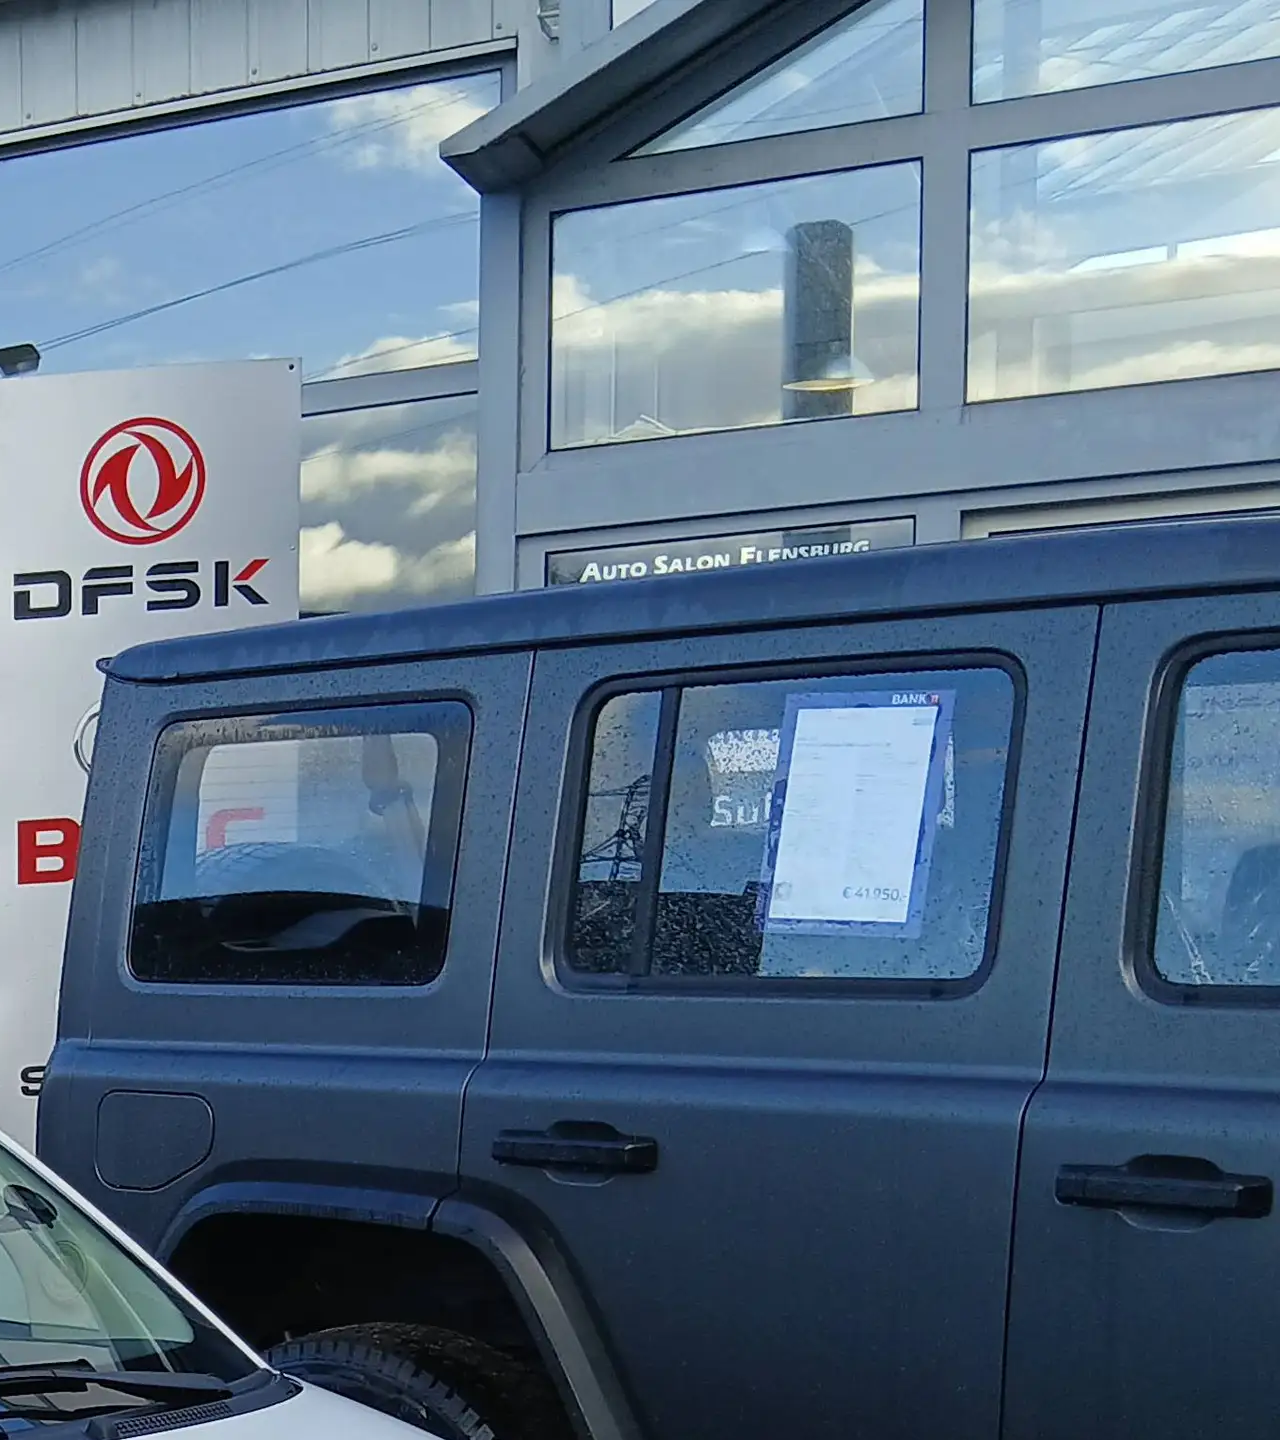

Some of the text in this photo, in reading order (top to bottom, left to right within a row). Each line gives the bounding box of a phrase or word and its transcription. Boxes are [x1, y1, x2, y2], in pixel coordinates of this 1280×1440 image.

[13, 558, 270, 620] DFSK
[580, 561, 647, 583] AUTO
[654, 553, 730, 575] SALON
